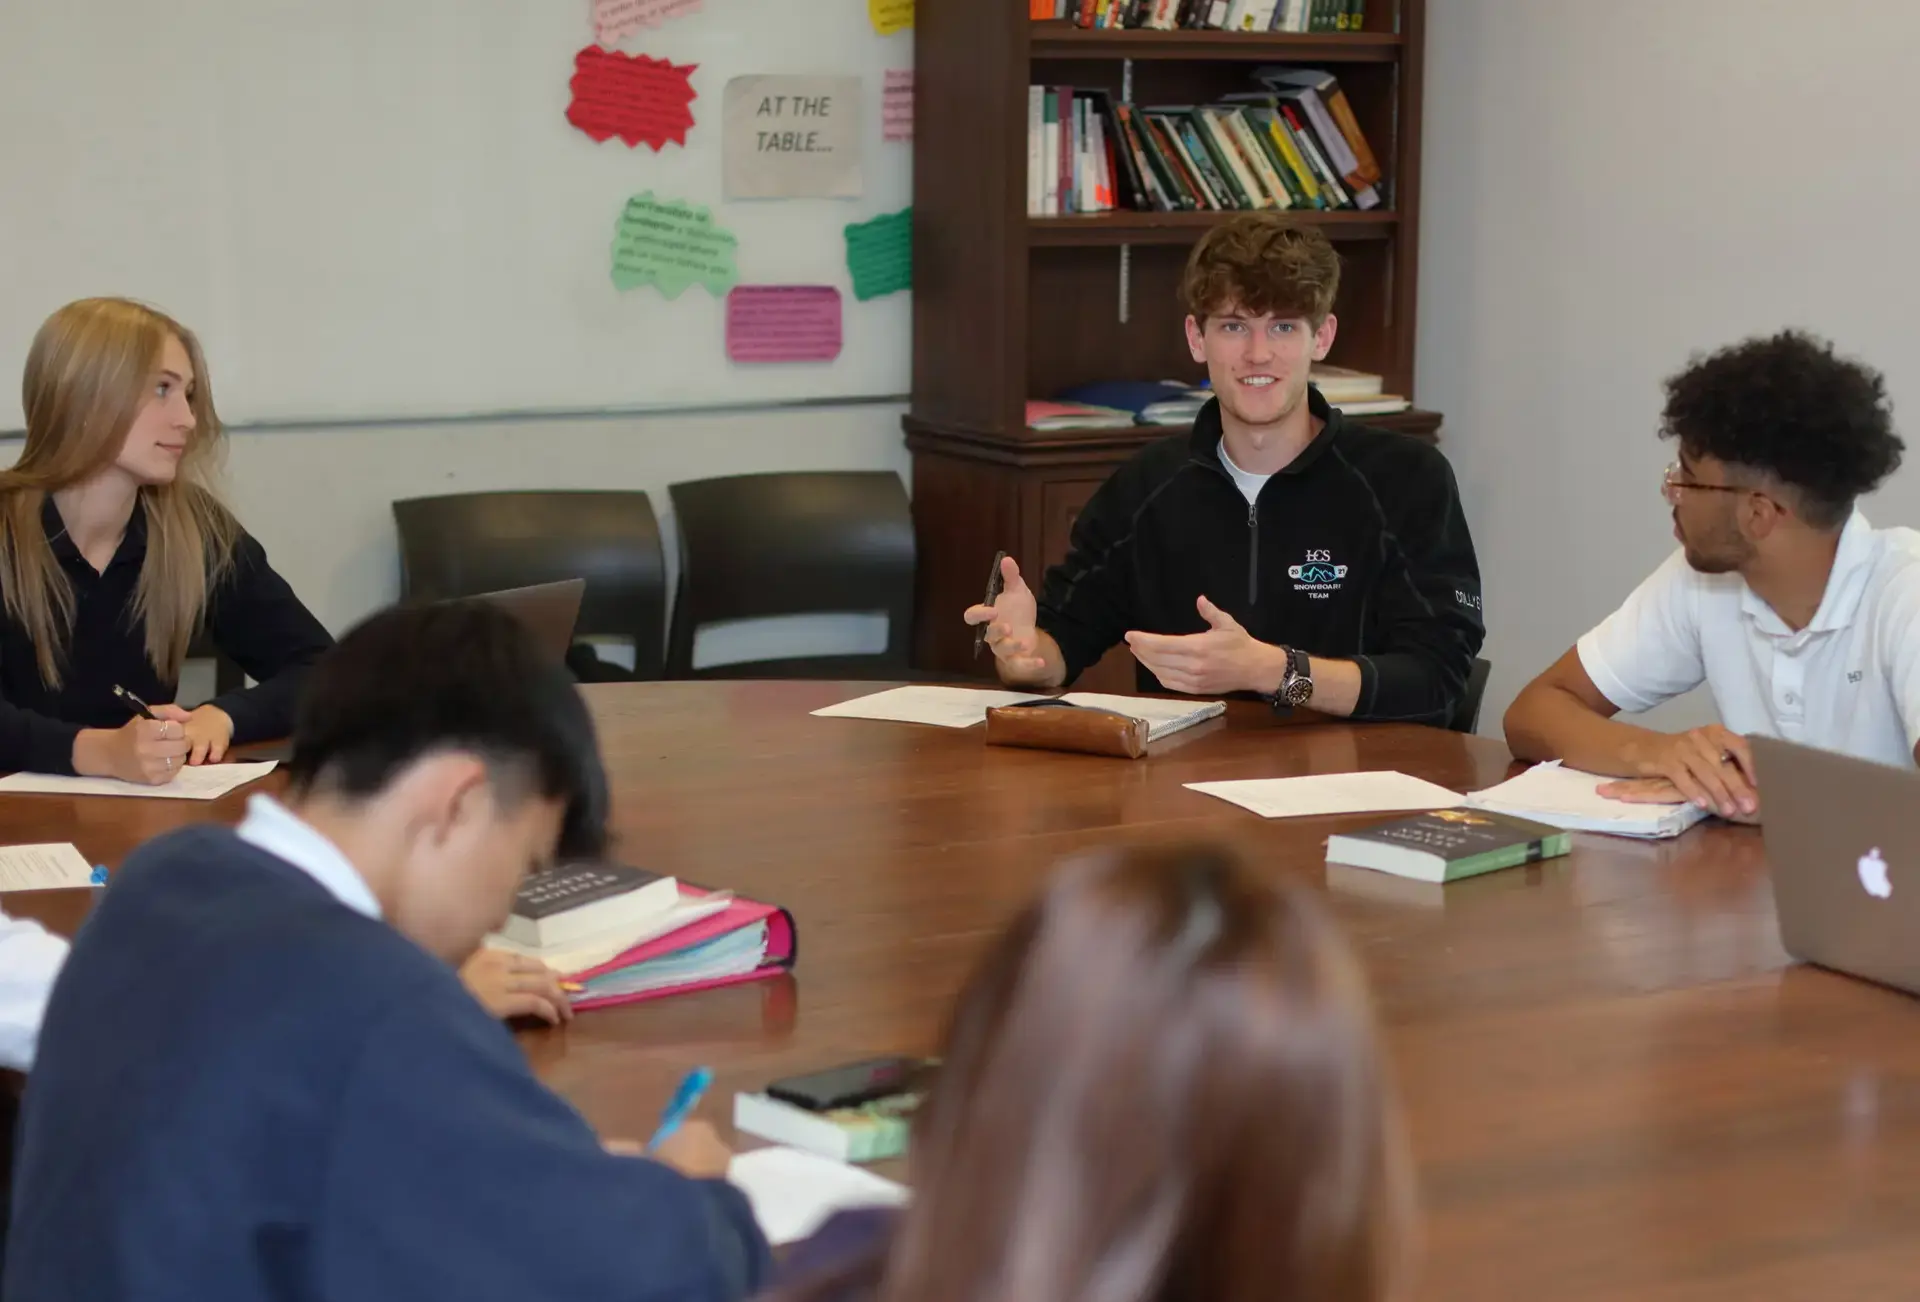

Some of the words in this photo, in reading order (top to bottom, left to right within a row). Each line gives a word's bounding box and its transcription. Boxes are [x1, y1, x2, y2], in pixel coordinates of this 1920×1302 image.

[756, 96, 788, 117] AT
[793, 96, 832, 117] THE
[757, 131, 834, 152] TABLE...
